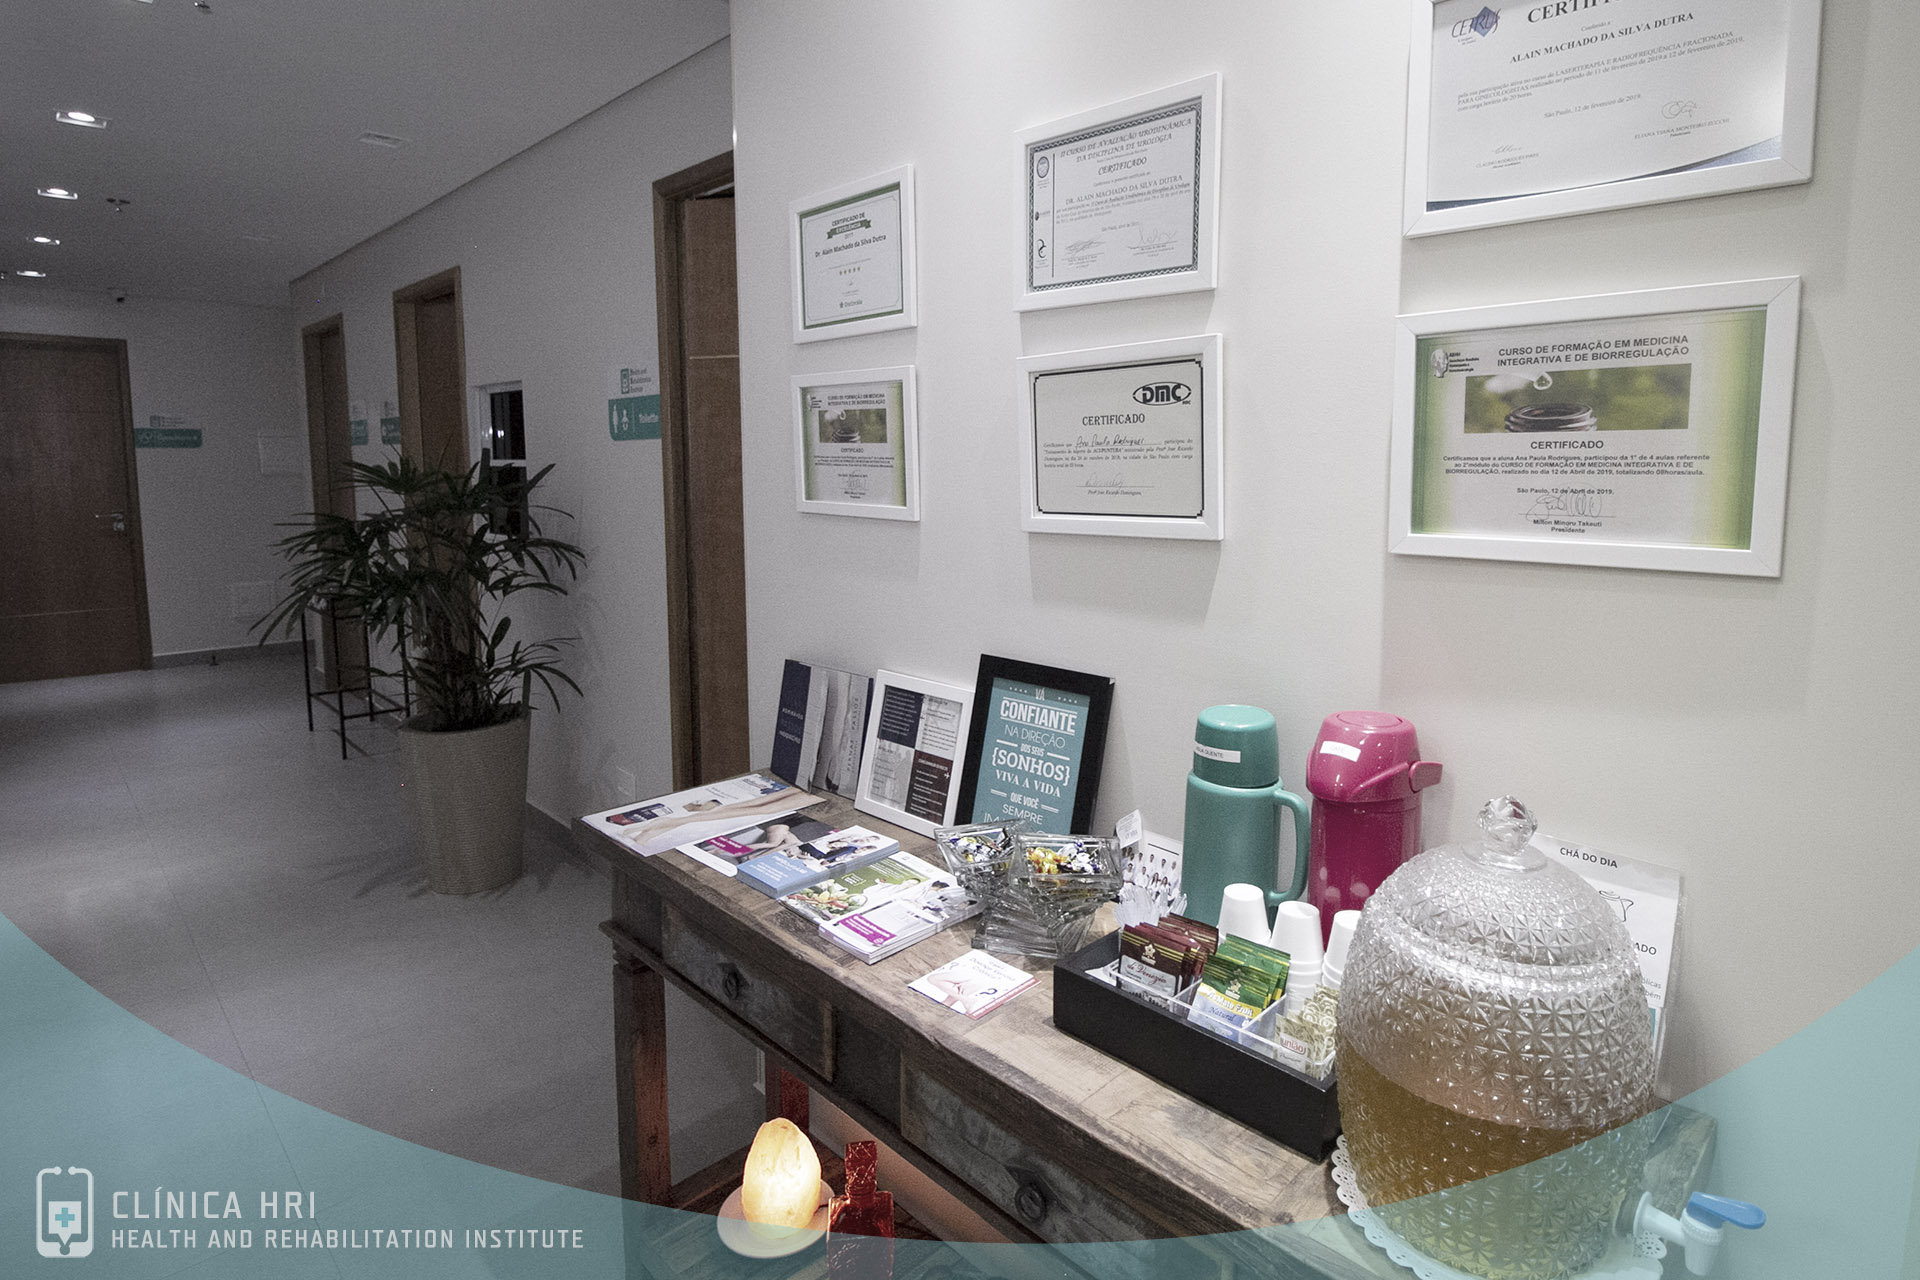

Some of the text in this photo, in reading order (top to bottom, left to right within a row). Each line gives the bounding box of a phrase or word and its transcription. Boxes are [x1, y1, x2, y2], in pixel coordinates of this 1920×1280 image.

[1510, 12, 1694, 64] ALAIN MACHADO DA SILVA DUTRA
[1556, 60, 1605, 76] LASERTERAPIA
[1612, 42, 1682, 64] RADIOFREQUÊNCIA
[1683, 30, 1734, 47] FRACIONADA
[1458, 97, 1474, 106] PARA
[1474, 84, 1529, 102] GINECOLOGISTAS
[1066, 146, 1086, 157] CURSO
[1098, 156, 1148, 176] CERTIFICADO
[1095, 186, 1128, 199] MACHADO
[1158, 174, 1183, 186] DUTRA
[1498, 335, 1688, 356] CURSO DE FORMAÇÃO EM MEDICINA
[1498, 346, 1689, 367] INTEGRATIVA E DE BIORREGULAÇÃO
[1142, 383, 1182, 404] DMC
[1082, 413, 1146, 426] CERTIFICADO
[1530, 440, 1604, 450] CERTIFICADO
[1535, 461, 1574, 469] FORMAÇÃO
[1548, 456, 1582, 464] Rodrigues,
[1036, 688, 1046, 702] VÁ
[1000, 700, 1078, 734] CONFIANTE
[1004, 724, 1066, 749] NA DIREÇÃO
[1020, 743, 1045, 757] DOS SEUS
[992, 747, 1070, 786] {SONHOS}
[995, 770, 1062, 798] VIVA A VIDA
[1010, 792, 1040, 810] QUE VOCÊ
[1002, 804, 1044, 825] SEMPRE
[1560, 845, 1618, 869] CHÁ DO DIA
[1210, 1005, 1236, 1022] Natural
[1281, 1037, 1305, 1054] união
